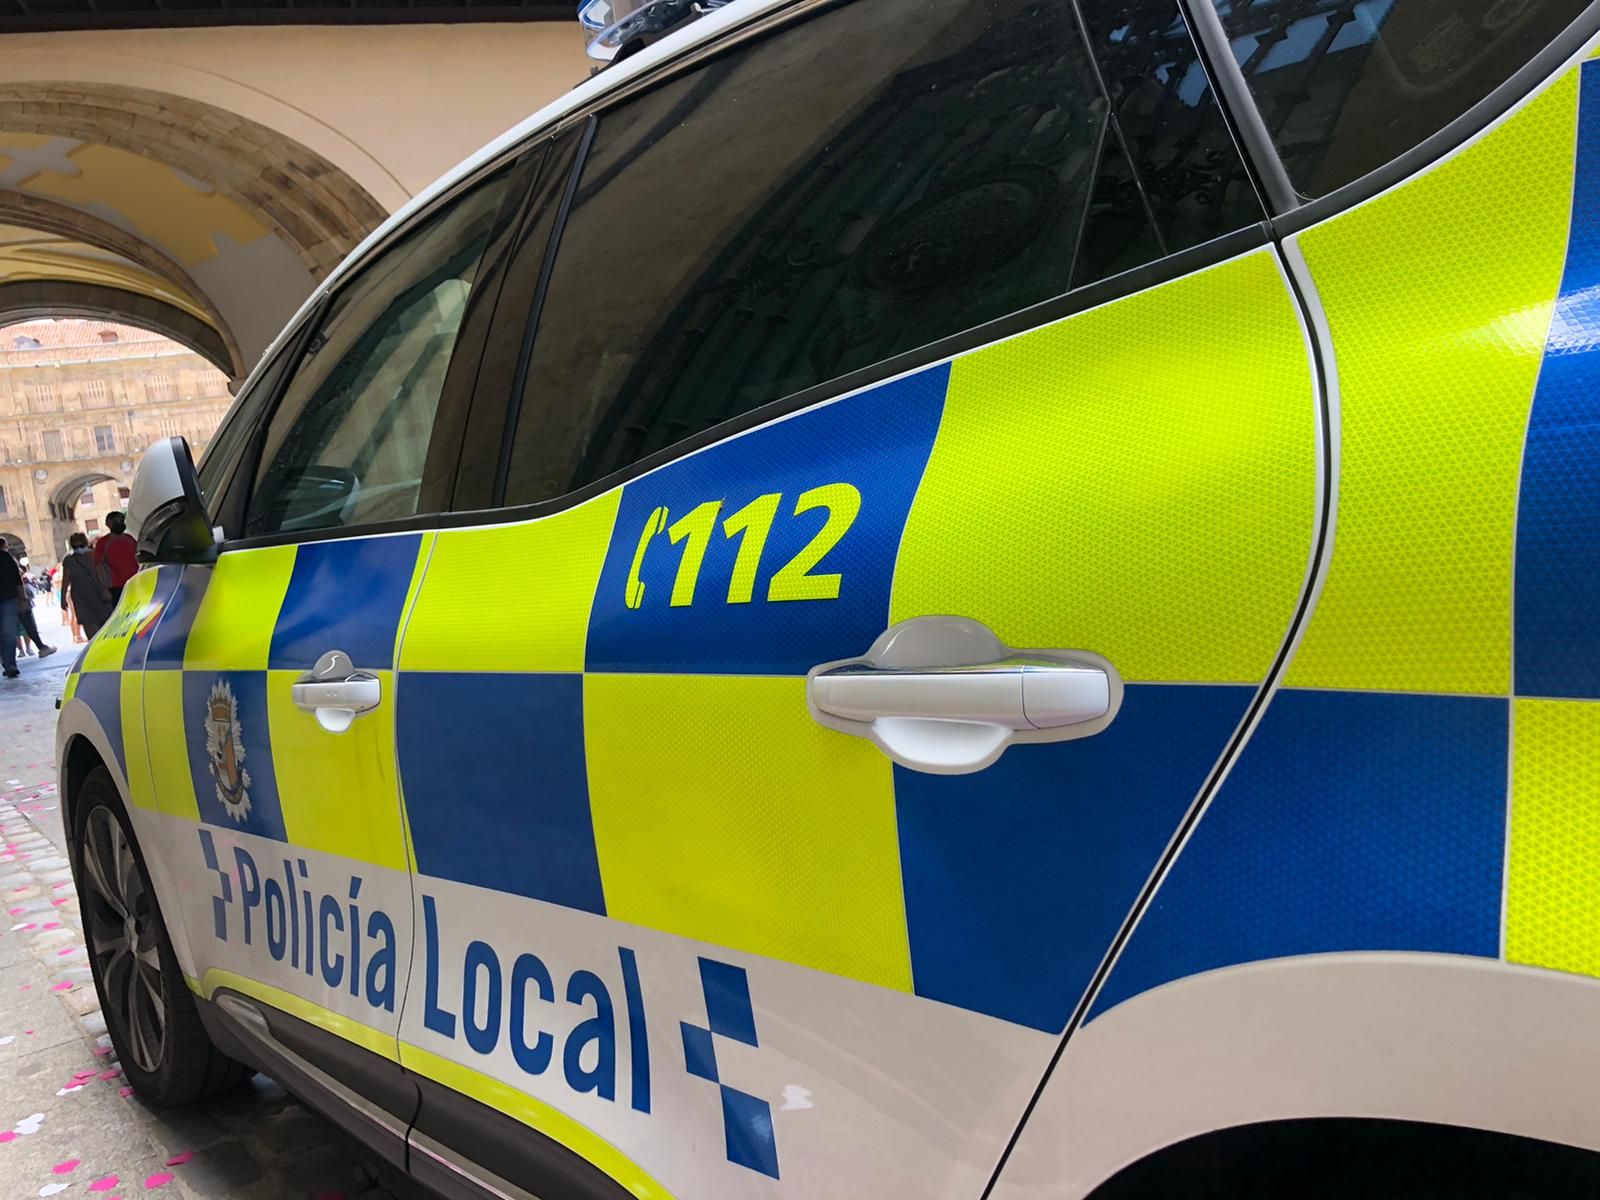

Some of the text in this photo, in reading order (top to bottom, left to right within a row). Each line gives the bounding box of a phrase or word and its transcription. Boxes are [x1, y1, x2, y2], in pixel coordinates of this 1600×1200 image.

[668, 483, 861, 606] 112
[233, 846, 651, 1115] Policía Local
